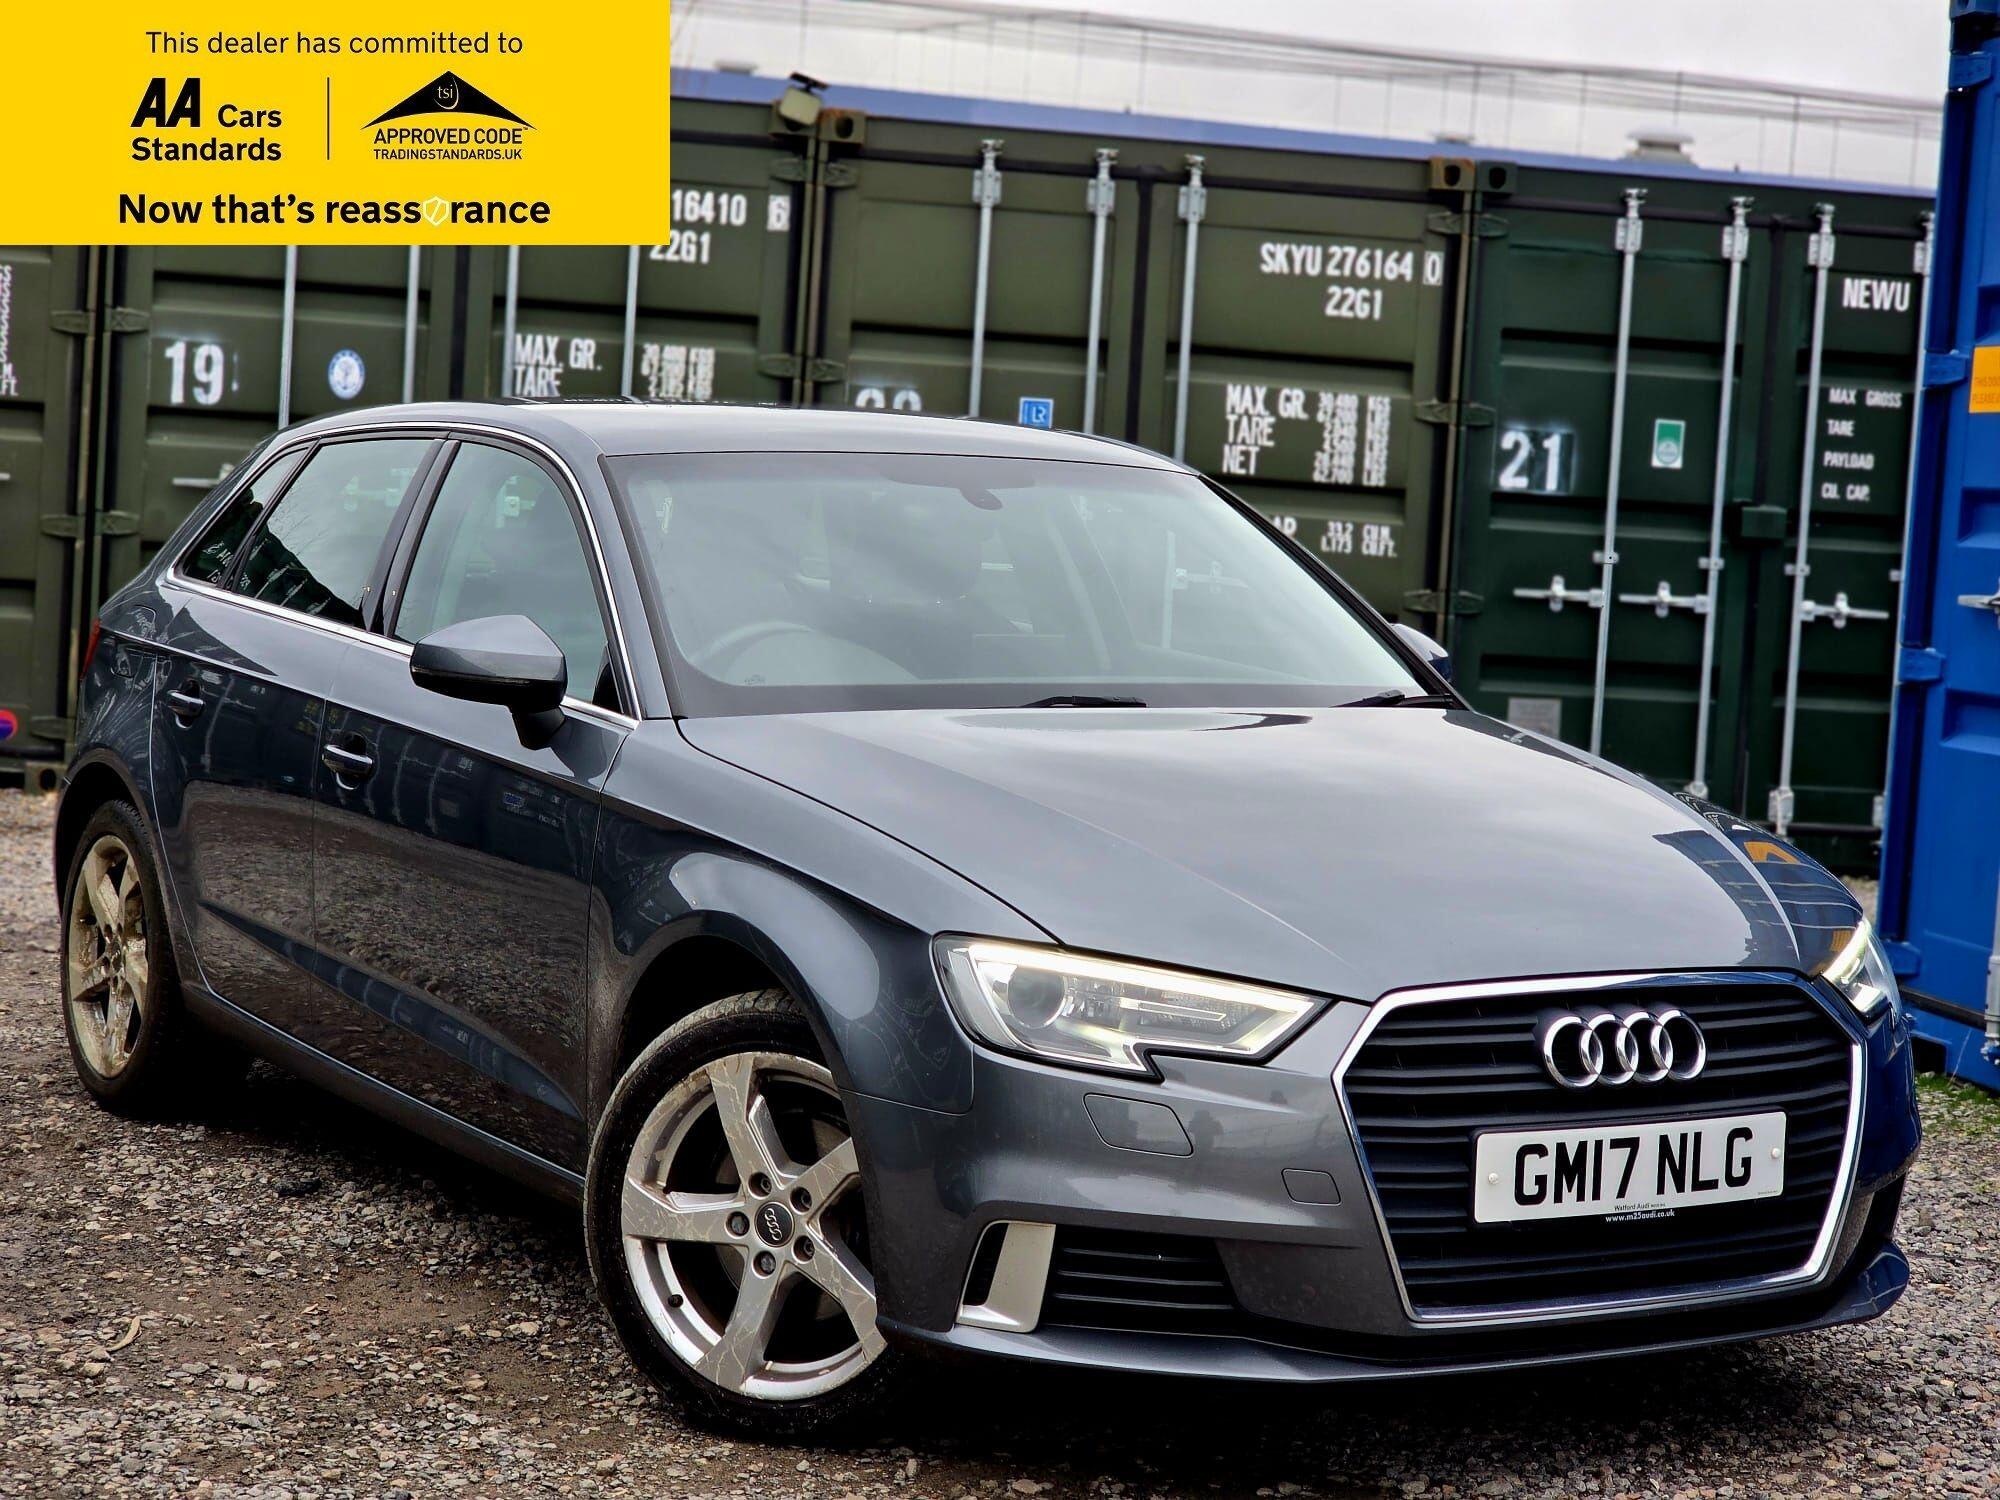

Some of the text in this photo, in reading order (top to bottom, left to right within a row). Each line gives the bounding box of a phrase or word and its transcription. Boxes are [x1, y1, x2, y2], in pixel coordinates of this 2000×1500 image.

[767, 196, 790, 231] 6
[1260, 242, 1323, 277] SKYU
[1326, 245, 1414, 283] 276164
[1325, 285, 1383, 321] 22G1
[1842, 277, 1911, 312] NEWU
[569, 337, 603, 371] GR.
[164, 340, 225, 406] 19
[1829, 387, 1902, 408] MAX GROSS
[1226, 414, 1276, 447] TARE
[1826, 419, 1855, 437] TARE
[1222, 444, 1260, 476] NET
[1500, 430, 1561, 491] 21
[1823, 450, 1875, 470] PAYLOAD
[1514, 1127, 1754, 1206] GM17 NLG
[1605, 1208, 1676, 1223] www.m25audi.co.uk
[1614, 1203, 1636, 1212] Watford
